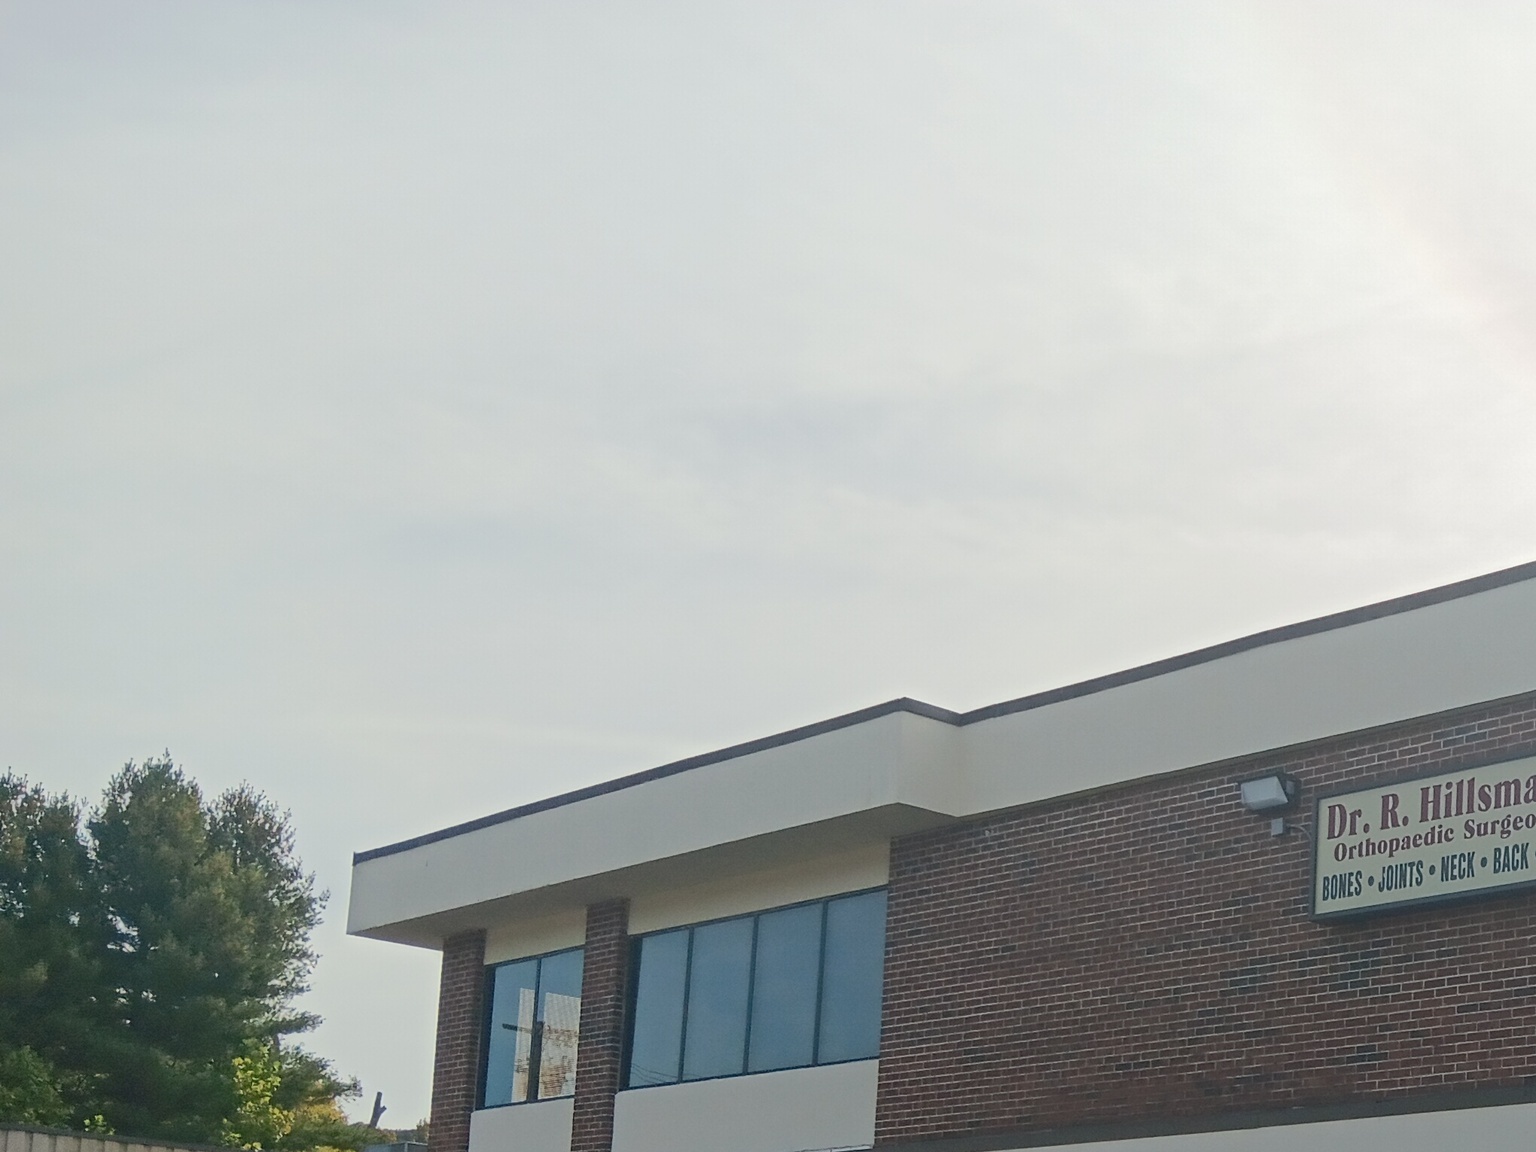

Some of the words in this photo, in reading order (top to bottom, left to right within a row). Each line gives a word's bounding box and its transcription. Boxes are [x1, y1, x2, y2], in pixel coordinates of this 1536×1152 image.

[1327, 803, 1370, 840] Dr.
[1380, 793, 1409, 830] R.
[1334, 824, 1454, 862] Orthopaedic
[1322, 870, 1362, 901] BONES
[1378, 860, 1423, 892] JOINTS
[1440, 851, 1476, 882] NECK
[1493, 842, 1529, 874] BACK
